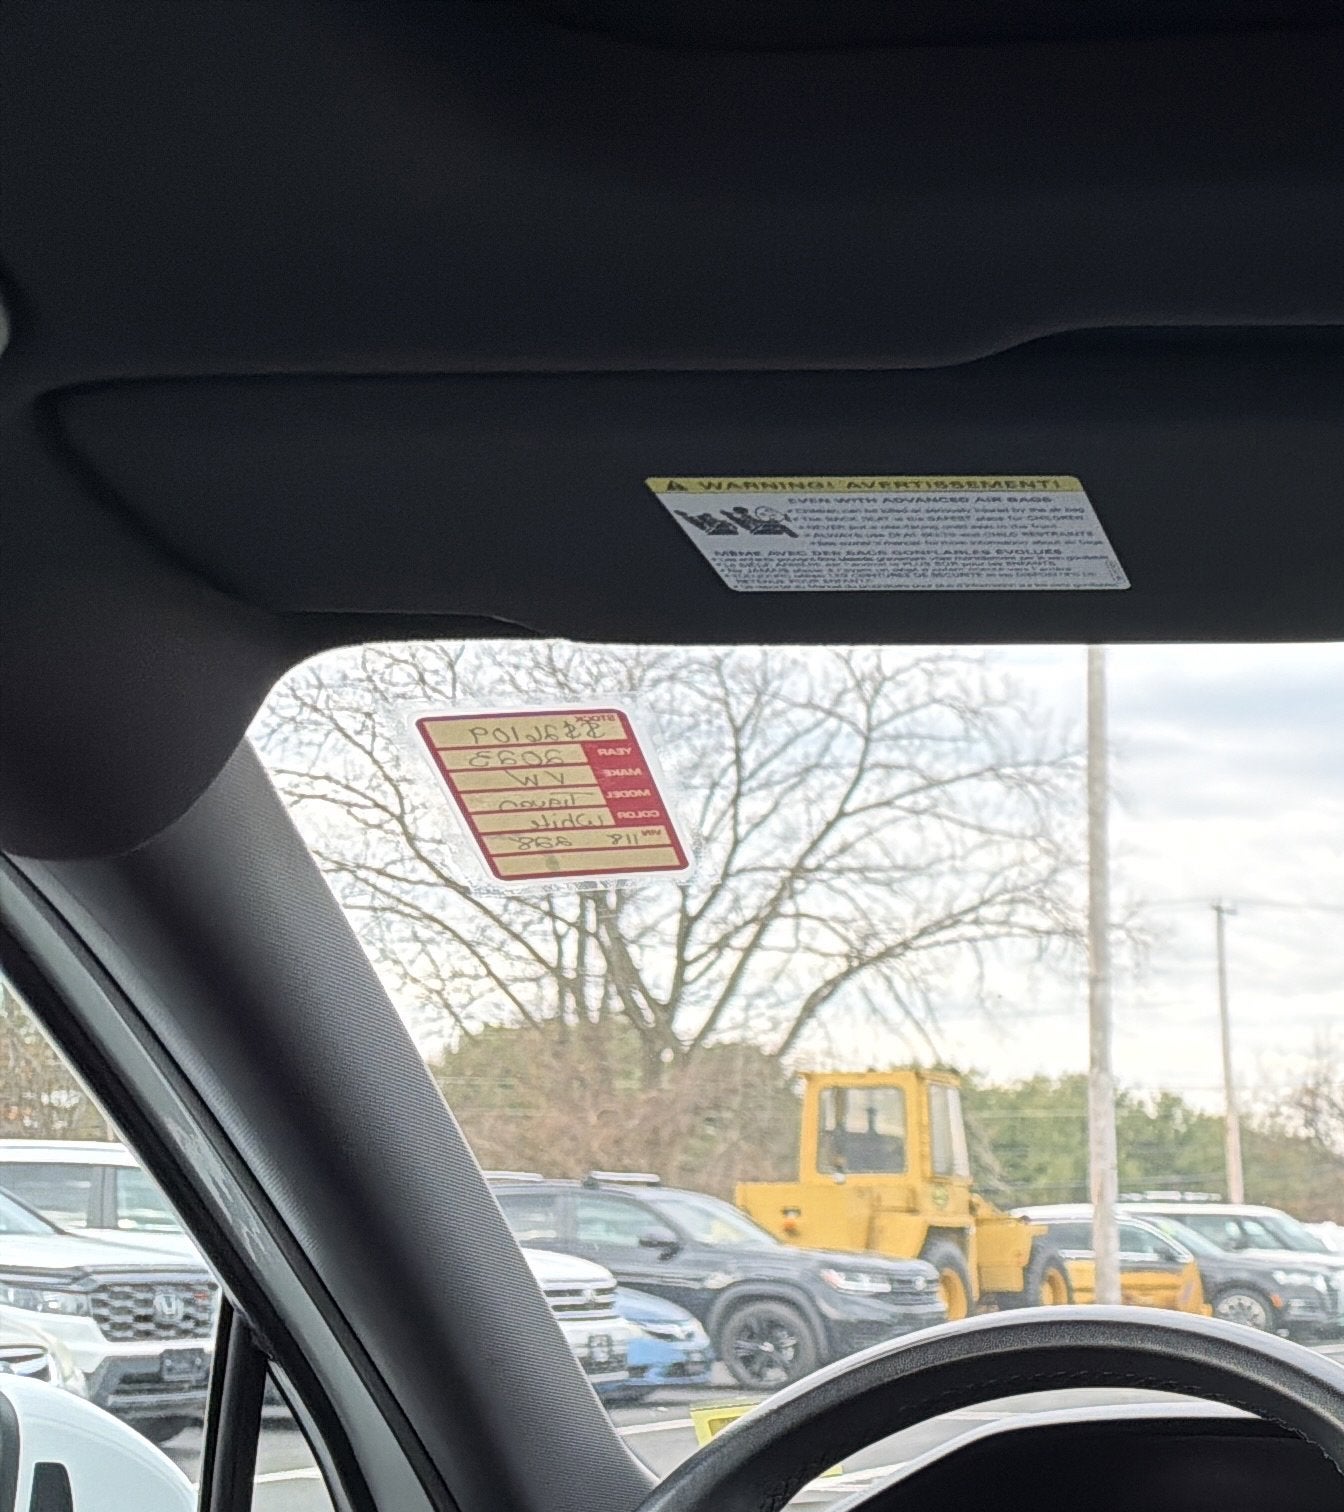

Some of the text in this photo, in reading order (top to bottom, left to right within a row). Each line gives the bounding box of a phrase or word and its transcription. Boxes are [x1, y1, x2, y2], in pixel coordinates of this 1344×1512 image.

[699, 479, 1061, 491] WARNING! AVERTISSEMENT!
[882, 496, 969, 504] ADVANCED
